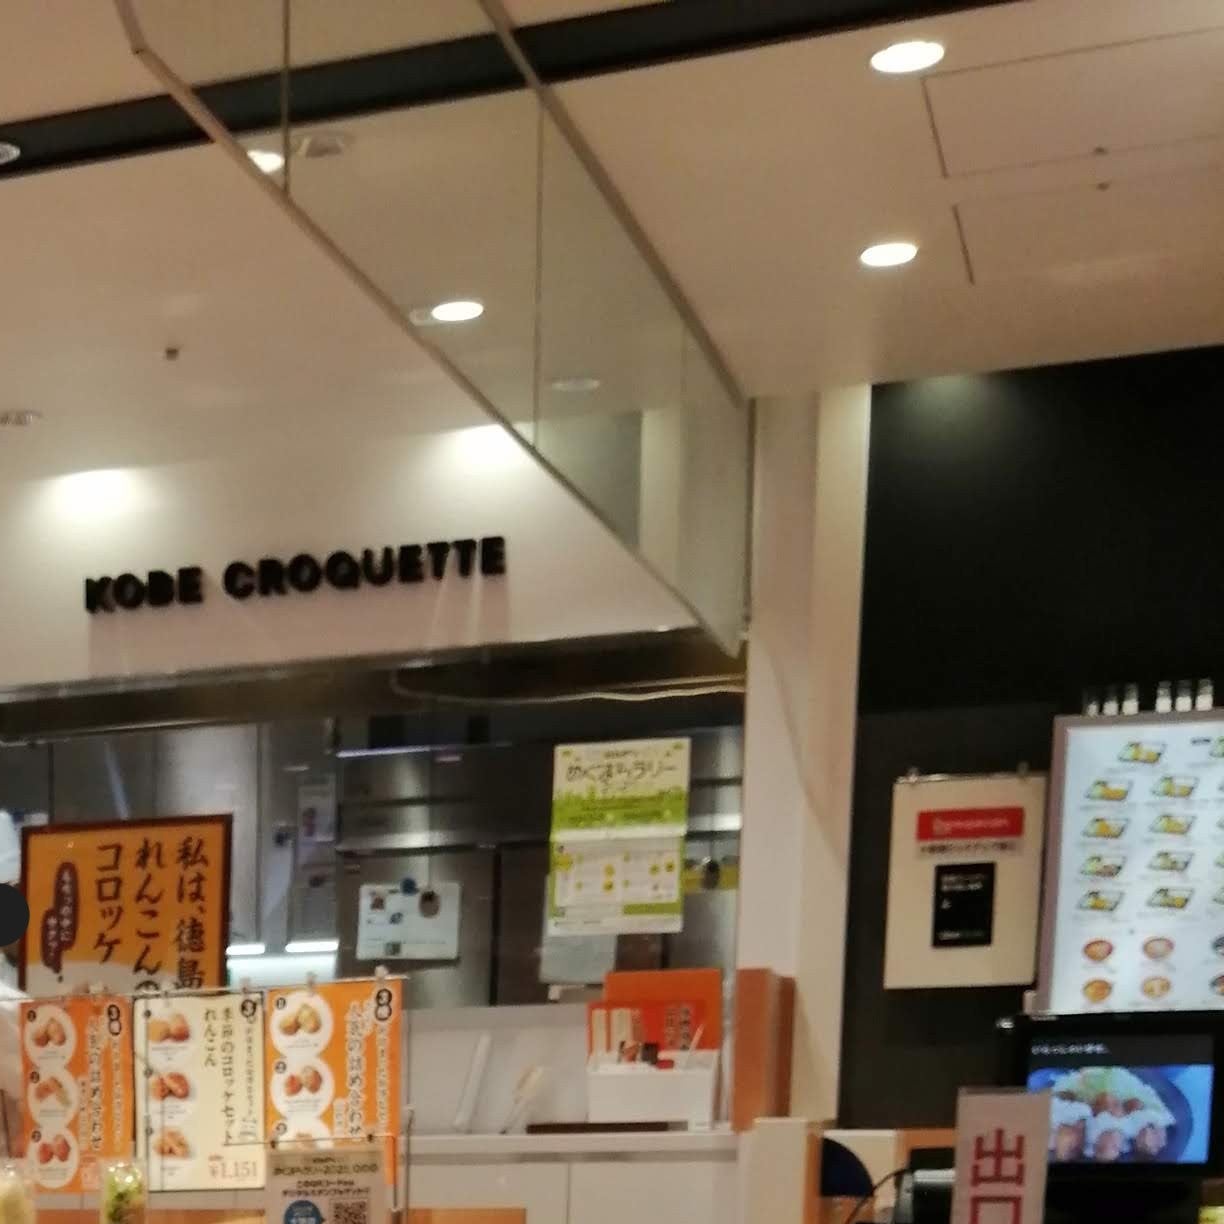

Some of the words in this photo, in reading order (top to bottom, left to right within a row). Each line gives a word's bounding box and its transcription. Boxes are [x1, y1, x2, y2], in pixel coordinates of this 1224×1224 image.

[85, 567, 203, 613] KOBE
[223, 536, 506, 599] CROQUETTE
[94, 843, 123, 963] コロッケ
